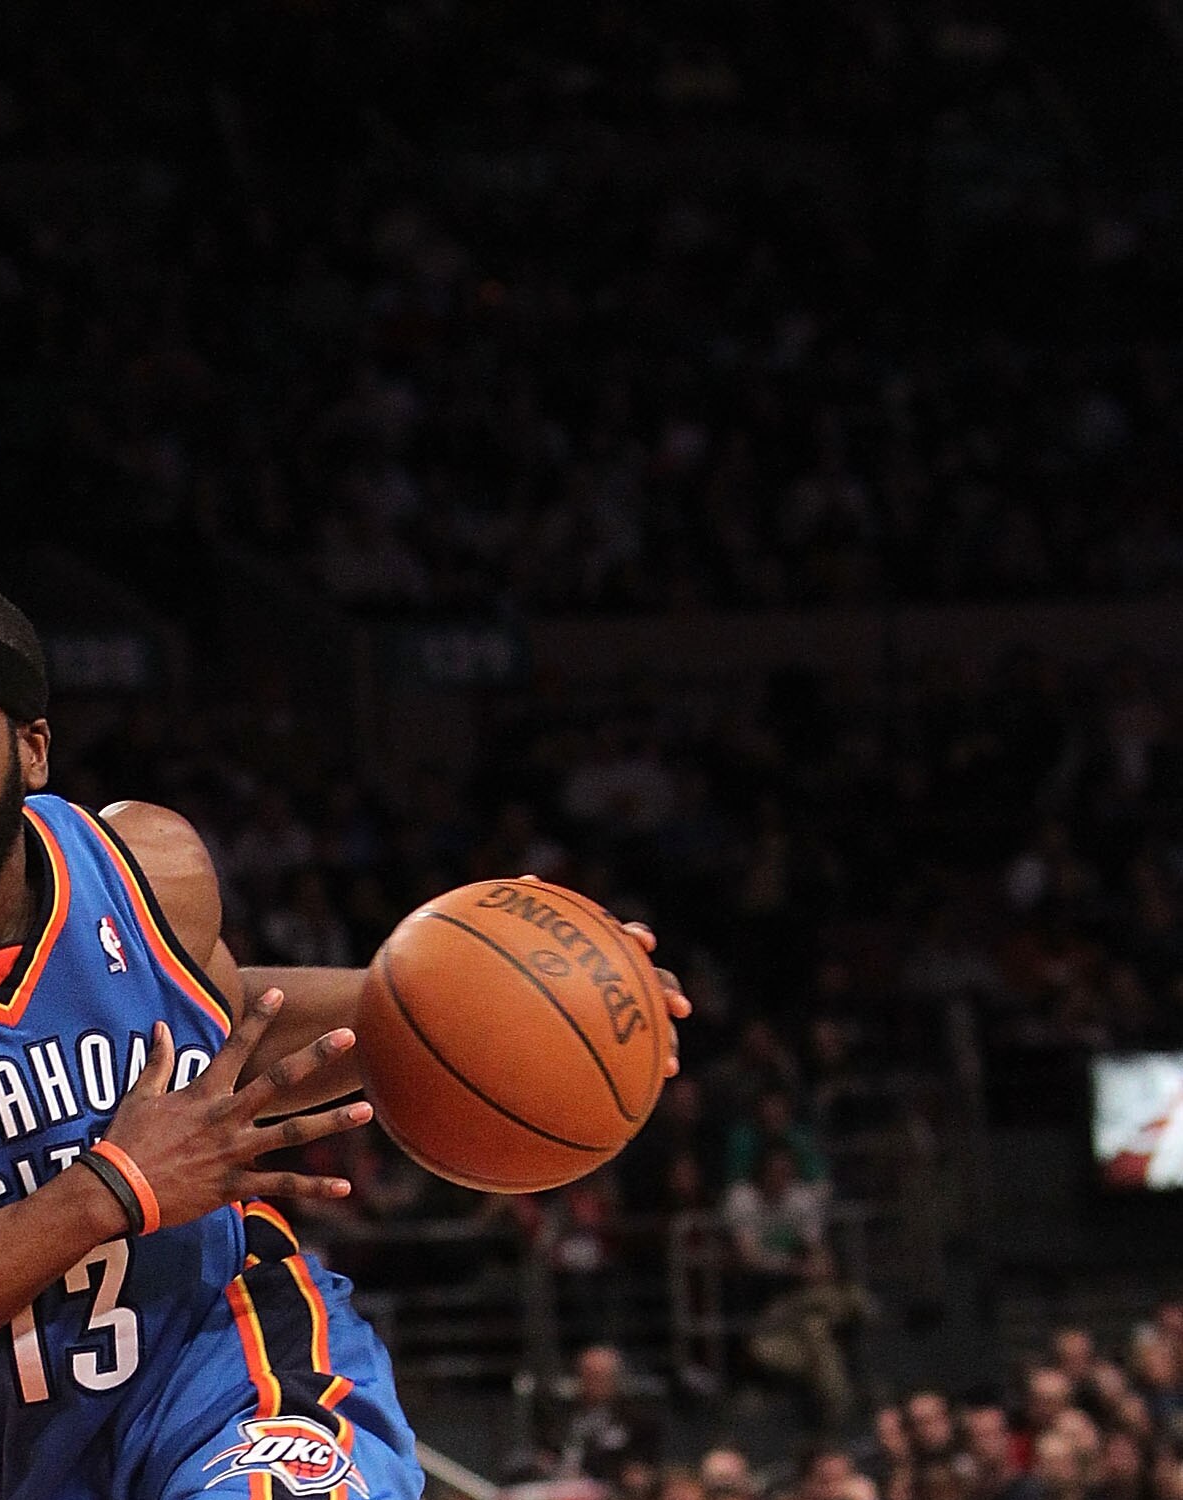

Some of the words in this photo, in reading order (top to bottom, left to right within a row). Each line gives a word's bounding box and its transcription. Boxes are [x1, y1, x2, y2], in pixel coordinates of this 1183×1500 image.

[477, 885, 647, 1045] SPALDING
[10, 1237, 140, 1404] 13
[239, 1436, 332, 1465] OKC
